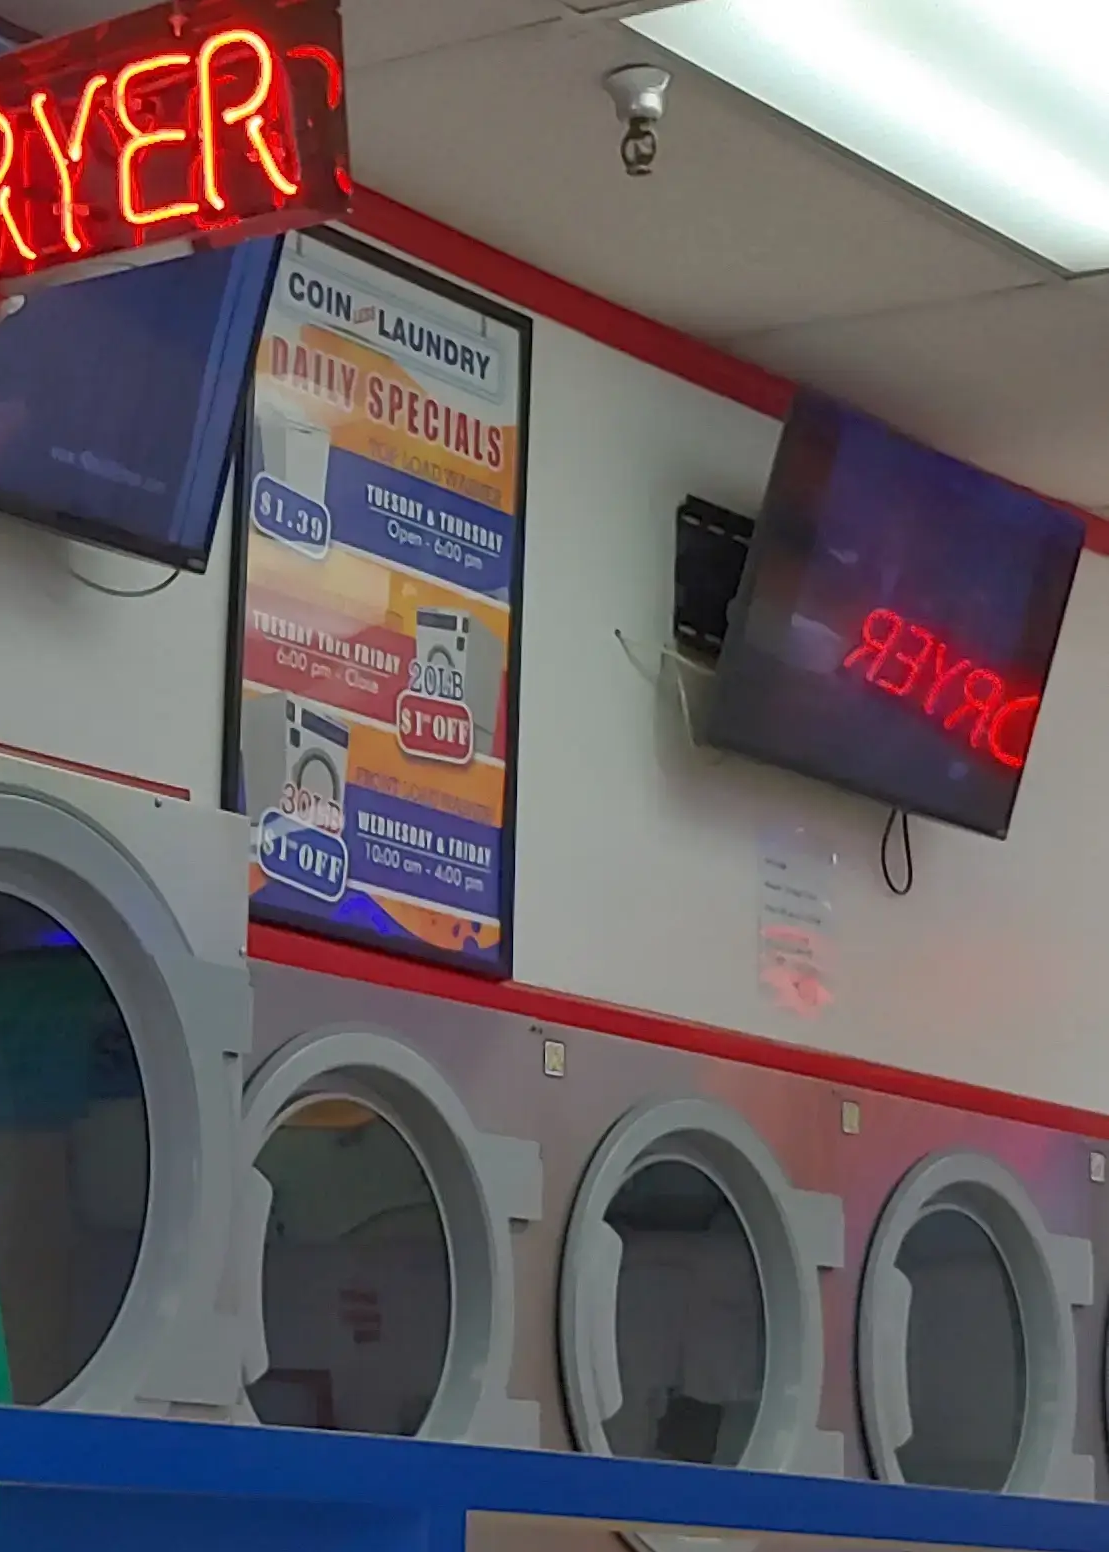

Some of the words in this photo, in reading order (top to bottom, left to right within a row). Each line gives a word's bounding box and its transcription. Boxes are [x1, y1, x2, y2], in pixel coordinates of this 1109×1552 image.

[288, 271, 352, 322] COIN
[377, 309, 491, 381] LAUNDRY
[271, 335, 357, 410] DAILY
[367, 373, 502, 469] SPECIALS
[259, 490, 323, 542] $1.39
[367, 483, 423, 521] TUESDAY
[427, 509, 435, 526] &
[440, 511, 503, 553] THURSDAY
[387, 519, 423, 546] Open
[434, 538, 462, 562] 6:00
[253, 609, 313, 647] TUESDAY
[355, 643, 401, 675] FRIDAY
[276, 646, 308, 672] 6:00
[311, 661, 332, 680] pm
[433, 714, 469, 746] OFF
[298, 843, 343, 884] OFF
[357, 809, 433, 850] WEDNESDAY
[448, 836, 491, 867] FRIDAY
[365, 841, 400, 869] 10:00
